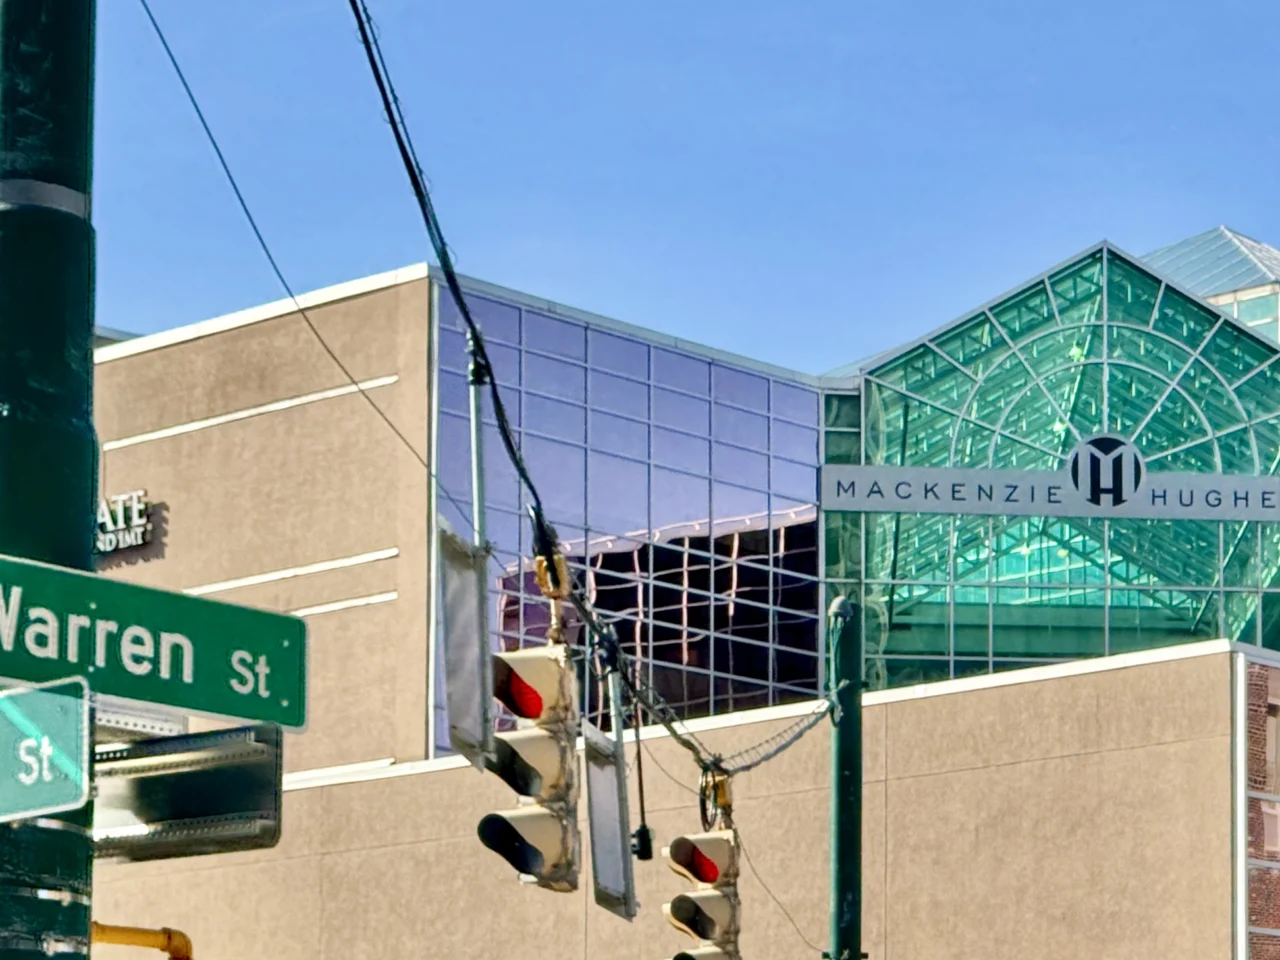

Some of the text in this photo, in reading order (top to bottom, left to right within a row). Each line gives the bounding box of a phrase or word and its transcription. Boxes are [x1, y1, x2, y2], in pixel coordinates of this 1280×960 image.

[836, 480, 1062, 503] MACKENZIE
[229, 650, 271, 698] St
[18, 735, 53, 785] St
